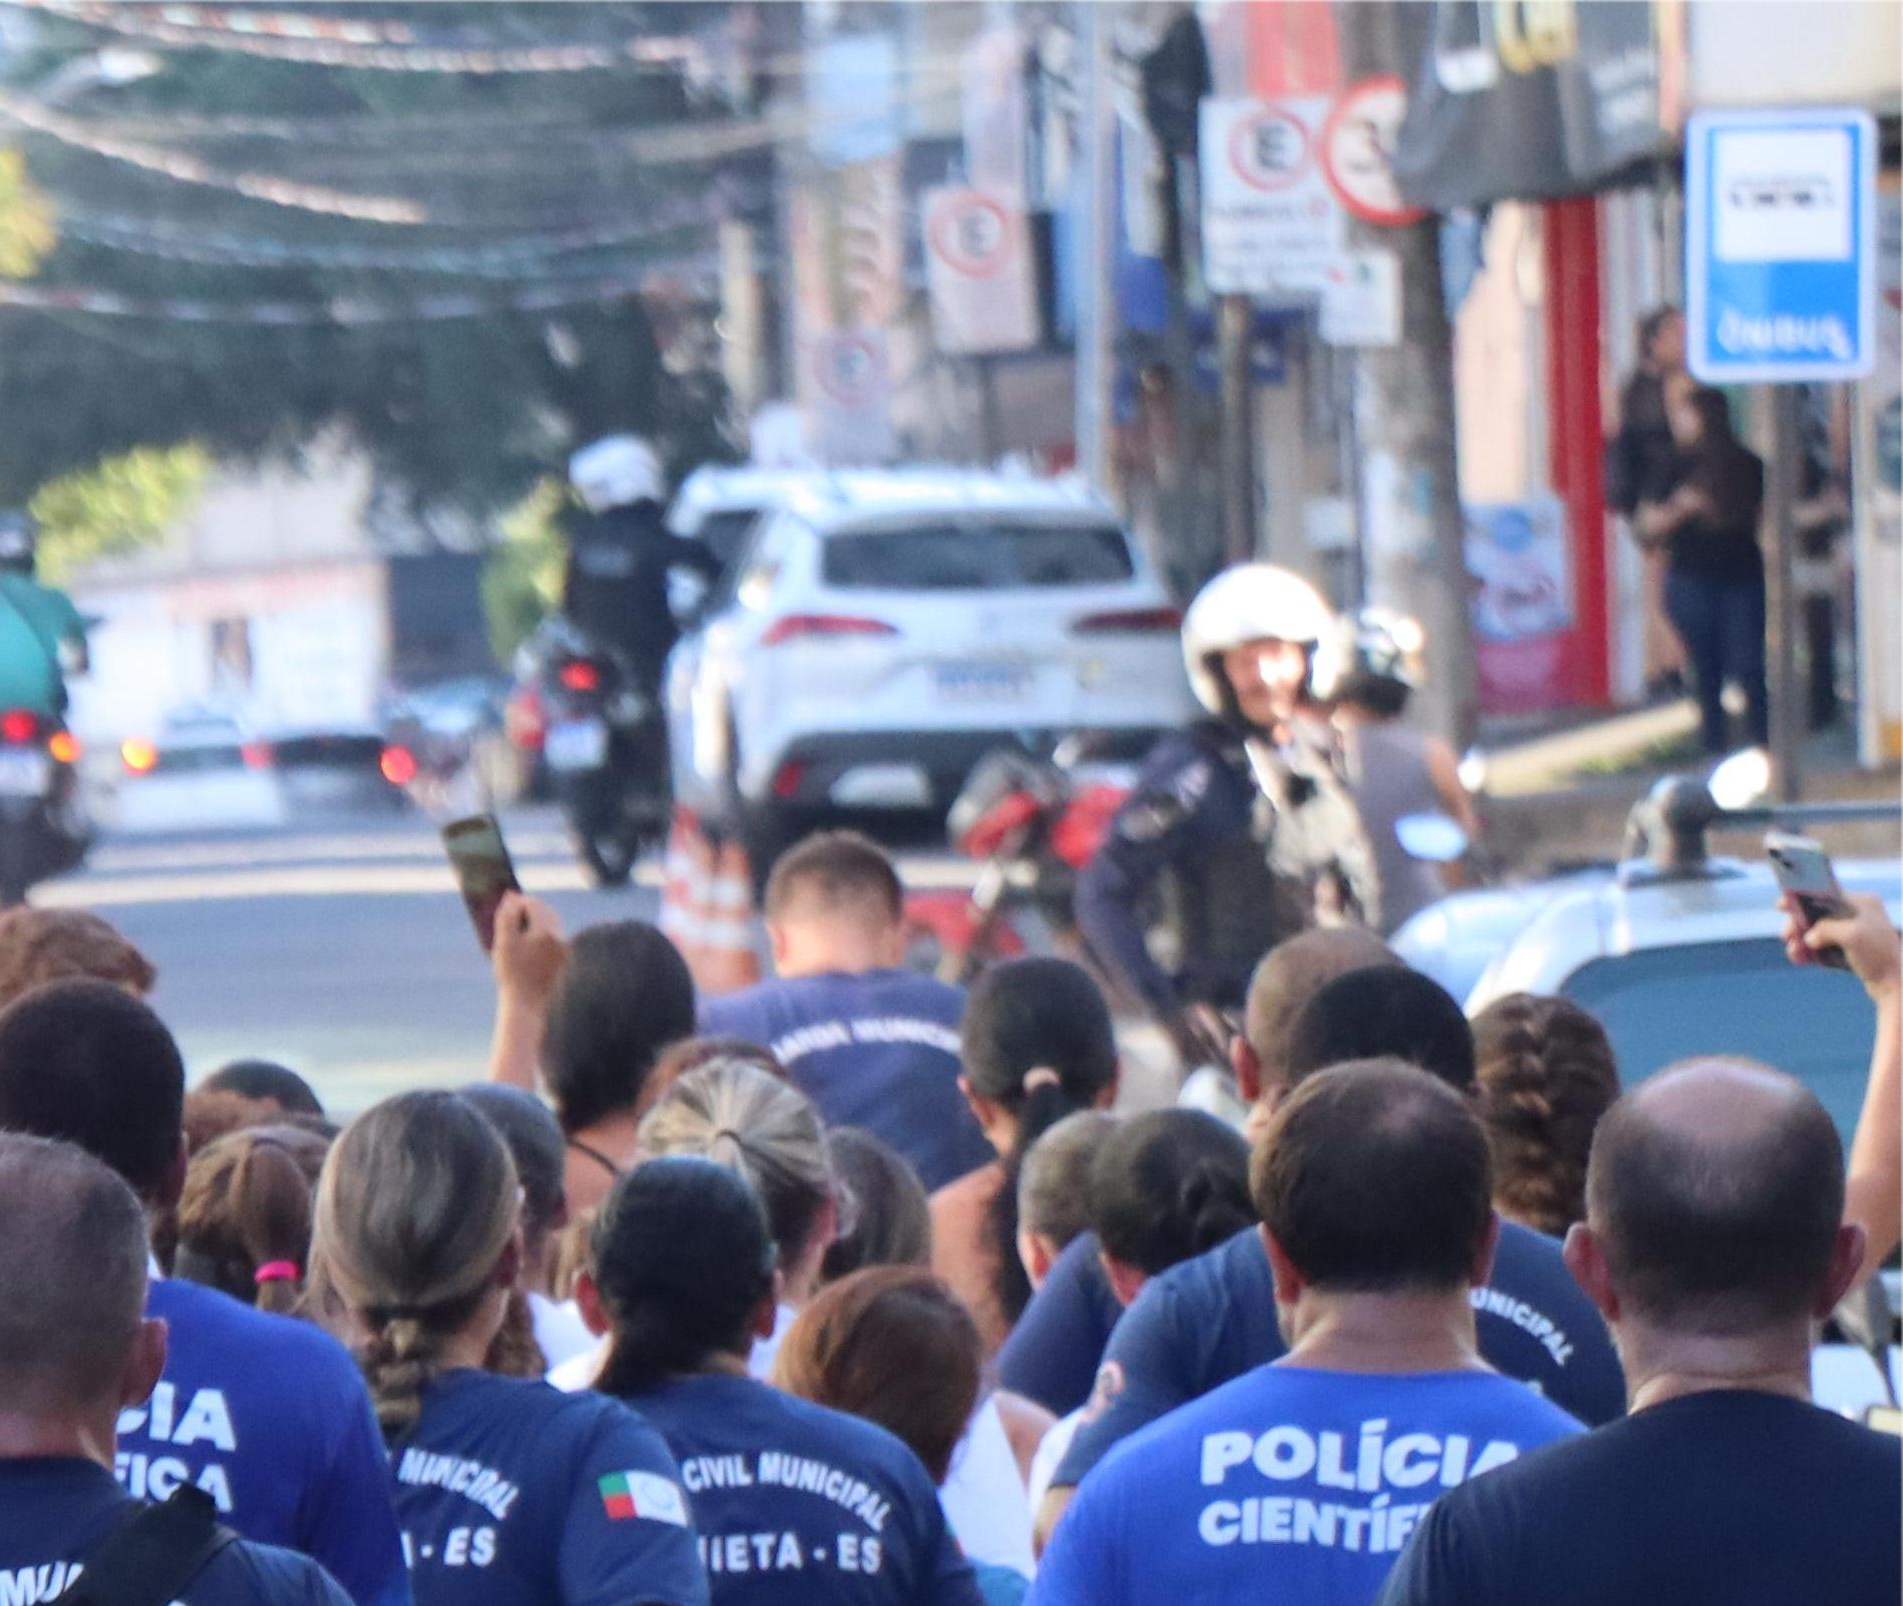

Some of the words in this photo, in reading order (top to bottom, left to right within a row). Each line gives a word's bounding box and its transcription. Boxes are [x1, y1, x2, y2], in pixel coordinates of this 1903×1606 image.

[1467, 1285, 1575, 1368] UNICIPAL
[681, 1453, 754, 1494] CIVIL
[757, 1451, 892, 1533] MUNICIPAL
[1198, 1492, 1432, 1555] CIENTÍF
[443, 1526, 497, 1569] ES
[836, 1532, 883, 1576] ES
